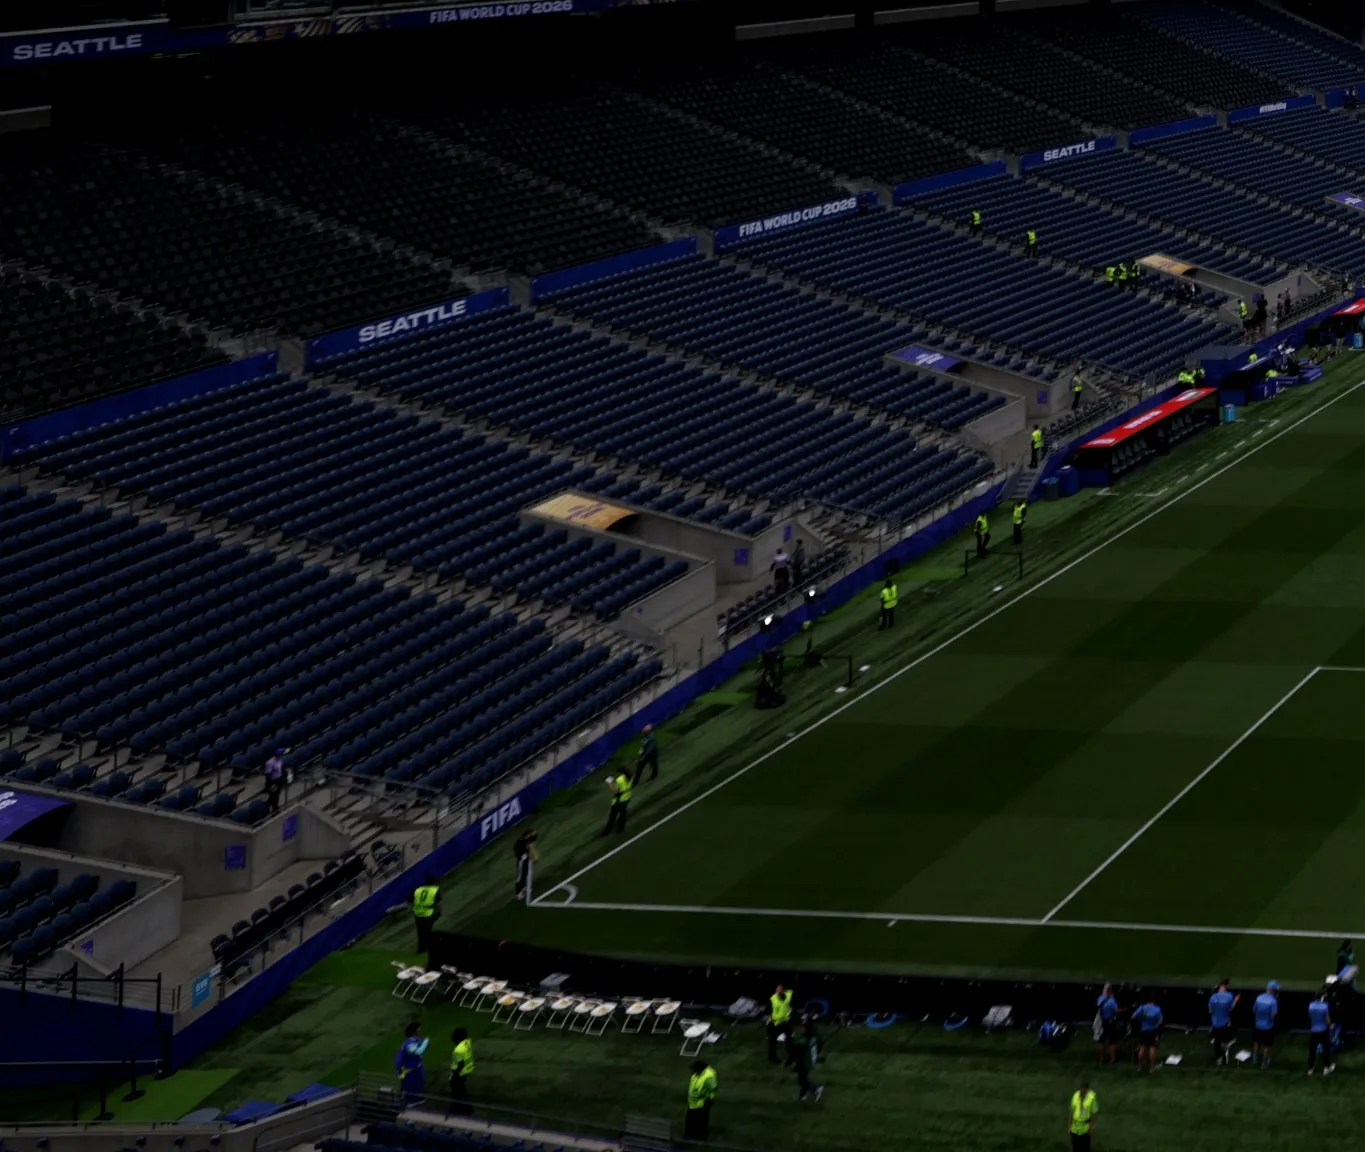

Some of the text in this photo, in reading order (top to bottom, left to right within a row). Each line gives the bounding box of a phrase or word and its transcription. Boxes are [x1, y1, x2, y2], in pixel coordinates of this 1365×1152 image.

[429, 8, 458, 24] FIFA
[459, 4, 505, 22] WORLD
[506, 2, 531, 18] CUP
[11, 32, 145, 61] SEATTLE
[1043, 140, 1096, 162] SEATTLE
[738, 196, 857, 238] FIFA WORLD CUP 2026
[358, 299, 468, 344] SEATTLE
[480, 796, 523, 843] FIFA
